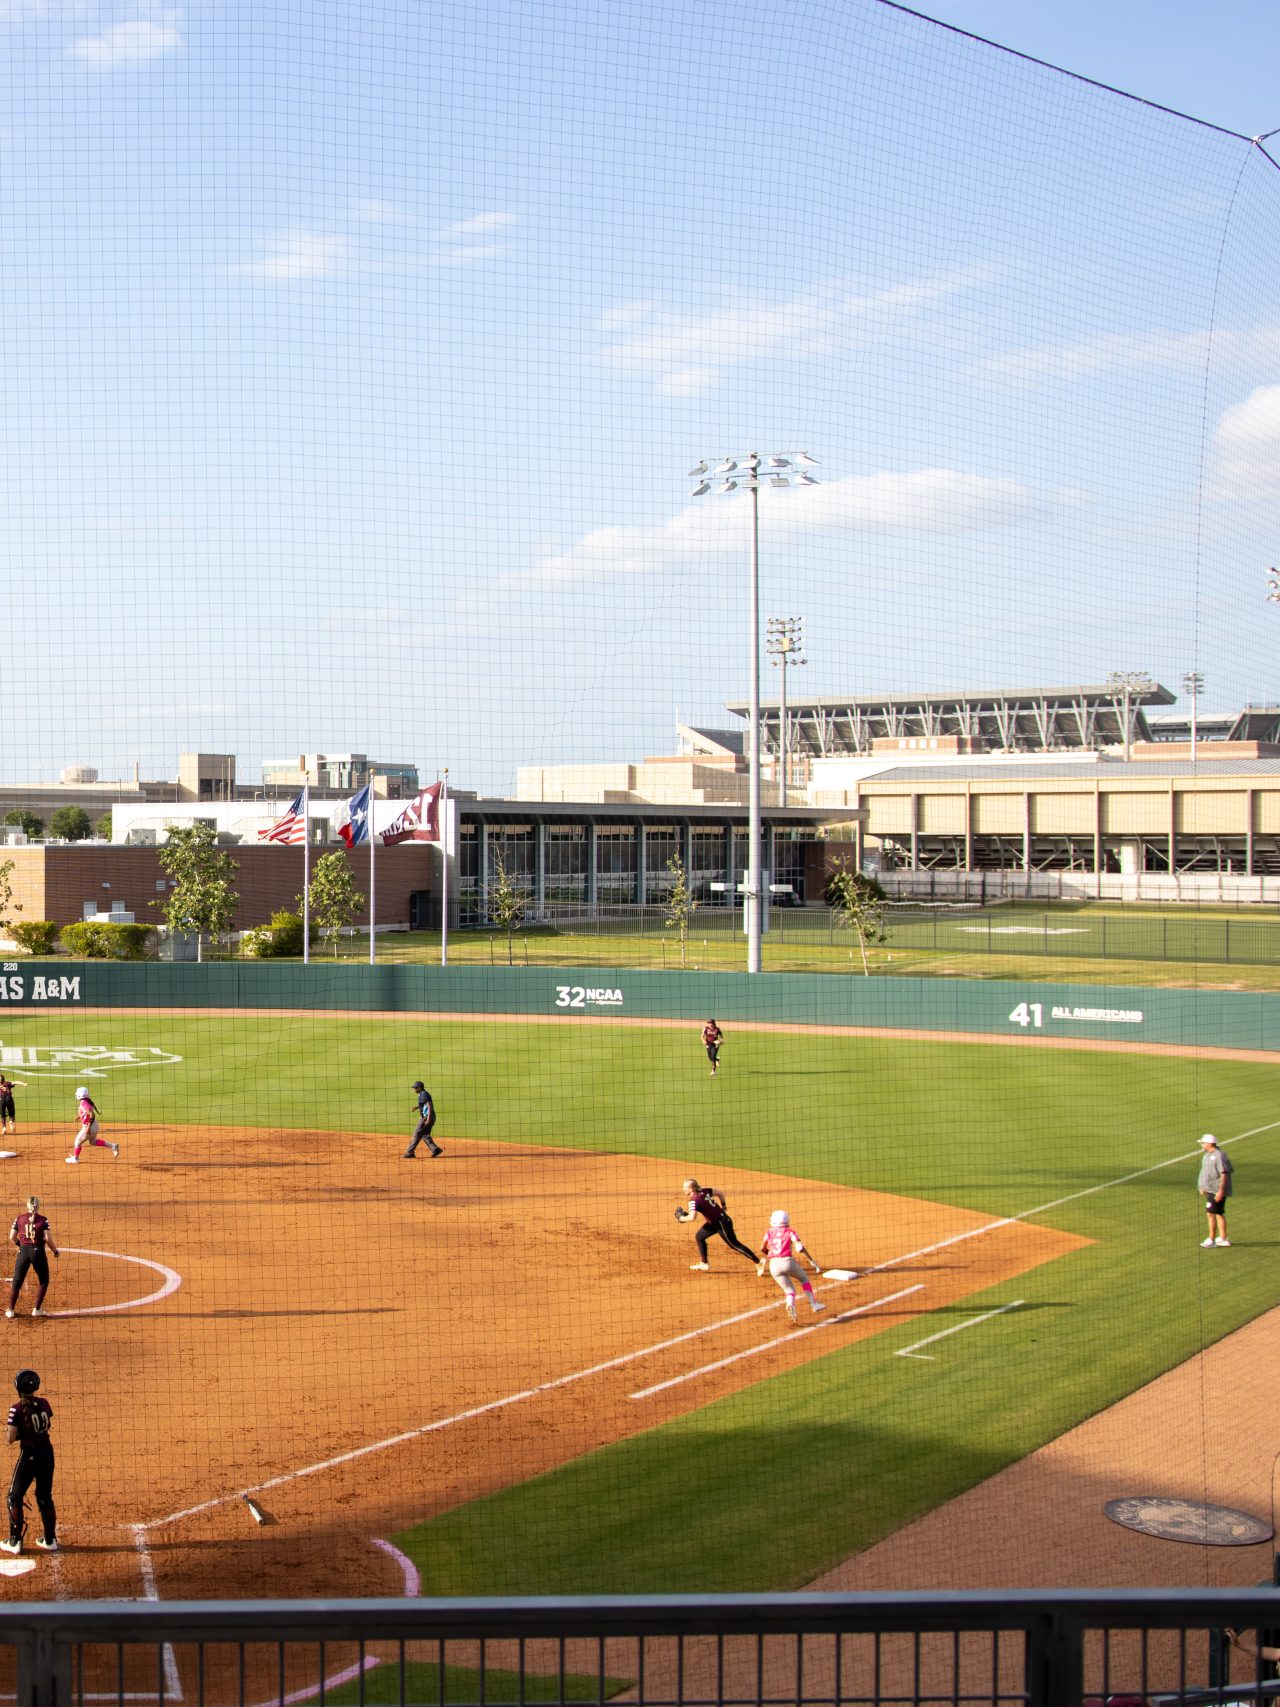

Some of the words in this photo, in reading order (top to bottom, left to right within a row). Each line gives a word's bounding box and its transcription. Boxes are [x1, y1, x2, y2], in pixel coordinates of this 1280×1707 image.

[3, 962, 18, 971] 220
[32, 976, 80, 1000] A&M
[555, 986, 586, 1007] 32
[586, 988, 624, 1001] NCAA
[1008, 1002, 1042, 1027] 41
[1051, 1006, 1072, 1017] ALL
[1073, 1007, 1143, 1021] AMERICANS
